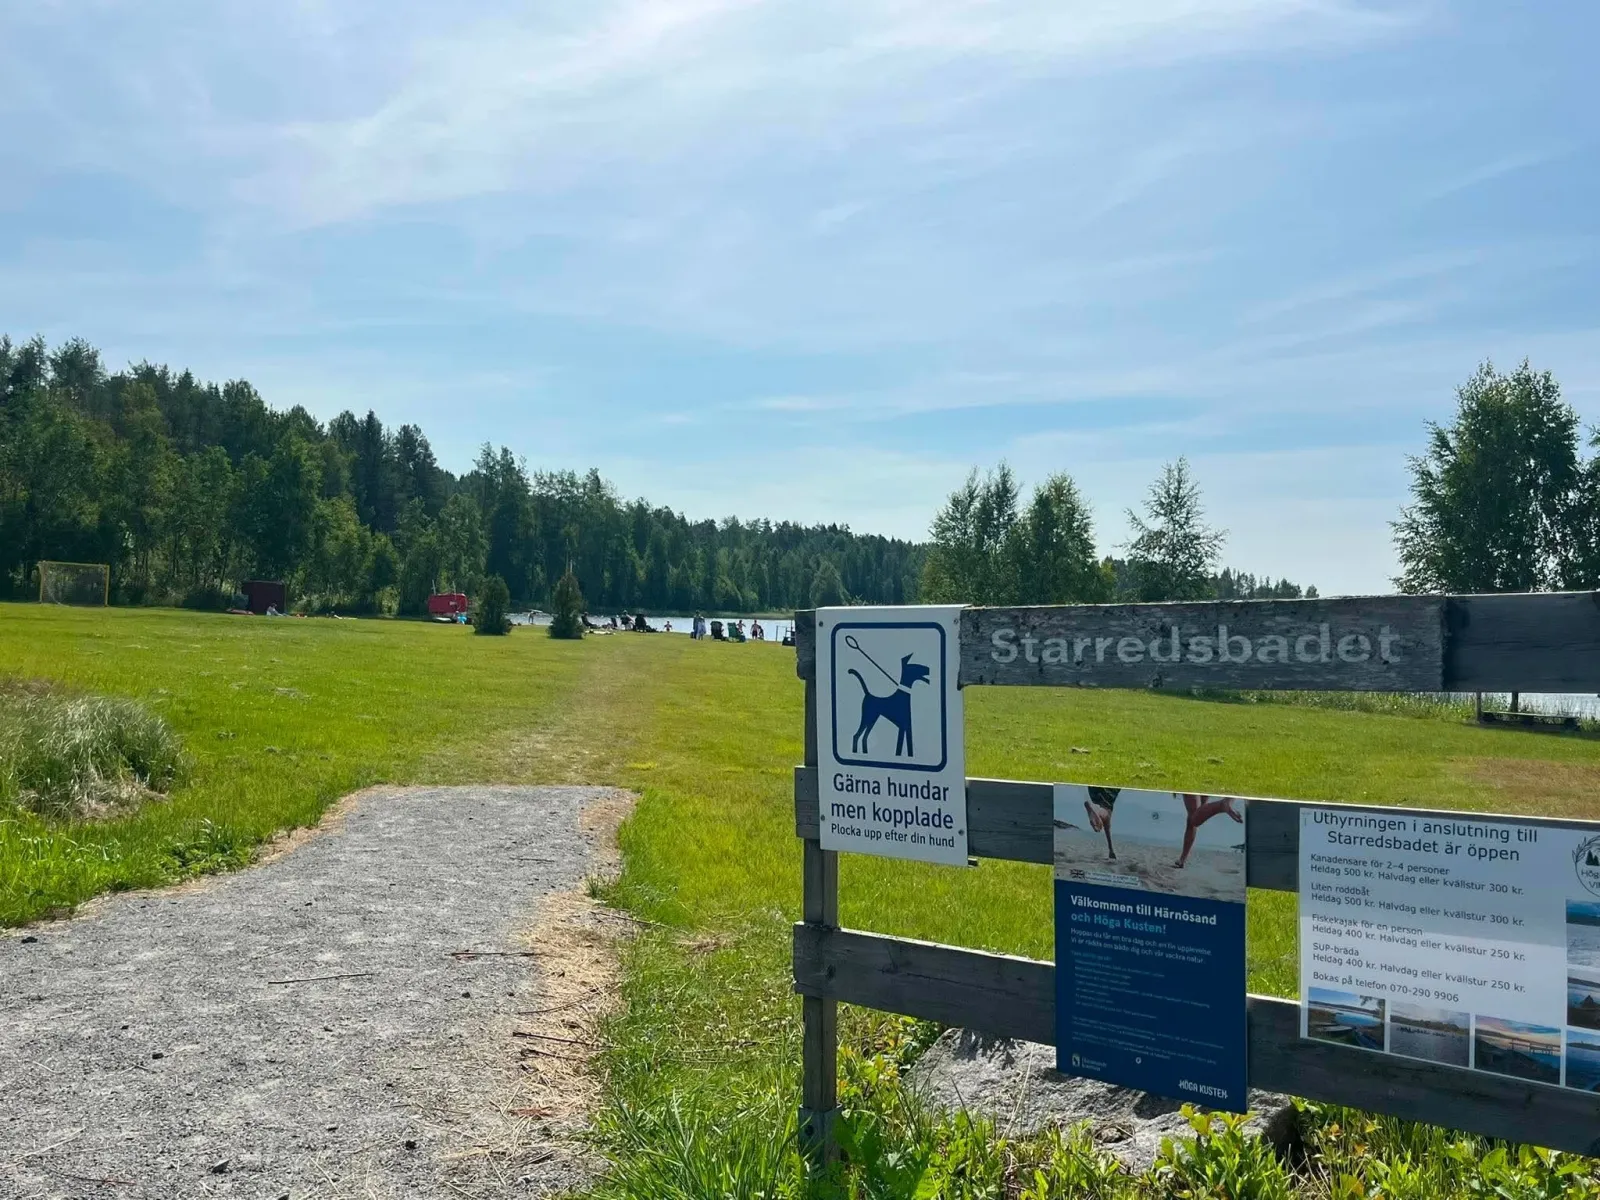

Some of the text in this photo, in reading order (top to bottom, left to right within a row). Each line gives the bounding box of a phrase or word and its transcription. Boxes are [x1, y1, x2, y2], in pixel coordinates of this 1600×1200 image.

[990, 622, 1403, 664] Starredsbadet
[833, 773, 949, 801] Gärna hundar
[831, 801, 954, 829] men kopplade
[1313, 811, 1538, 844] Uthyrningen i anslutning till
[831, 823, 955, 848] Plocka upp efter din hund
[1327, 830, 1520, 861] Starredsbadet är öppen
[1310, 853, 1368, 867] Kanadensare
[1370, 860, 1383, 868] för
[1407, 864, 1450, 875] personer
[1310, 864, 1341, 876] Heldag
[1344, 867, 1361, 877] 500
[1378, 871, 1415, 884] Halvdag
[1420, 876, 1440, 885] eller
[1443, 878, 1486, 891] kvällstur
[1489, 883, 1508, 893] 300
[1511, 886, 1524, 895] kr.
[1311, 882, 1370, 896] Liten roddbåt
[1070, 895, 1217, 925] Välkommen till Härnösand
[1071, 912, 1167, 934] och Höga Kusten!
[1311, 892, 1525, 927] Heldag 500 kr. Halvdag eller kvällstur 300 kr.
[1312, 913, 1423, 936] Fiskekajak för en person
[1312, 924, 1526, 961] Heldag 400 kr. Halvdag eller kvällstur 250 kr.
[1313, 953, 1526, 993] Heldag 400 kr. Halvdag eller kvällstur 250 kr.
[1313, 971, 1459, 1003] Bokas på telefon 070-290 9906
